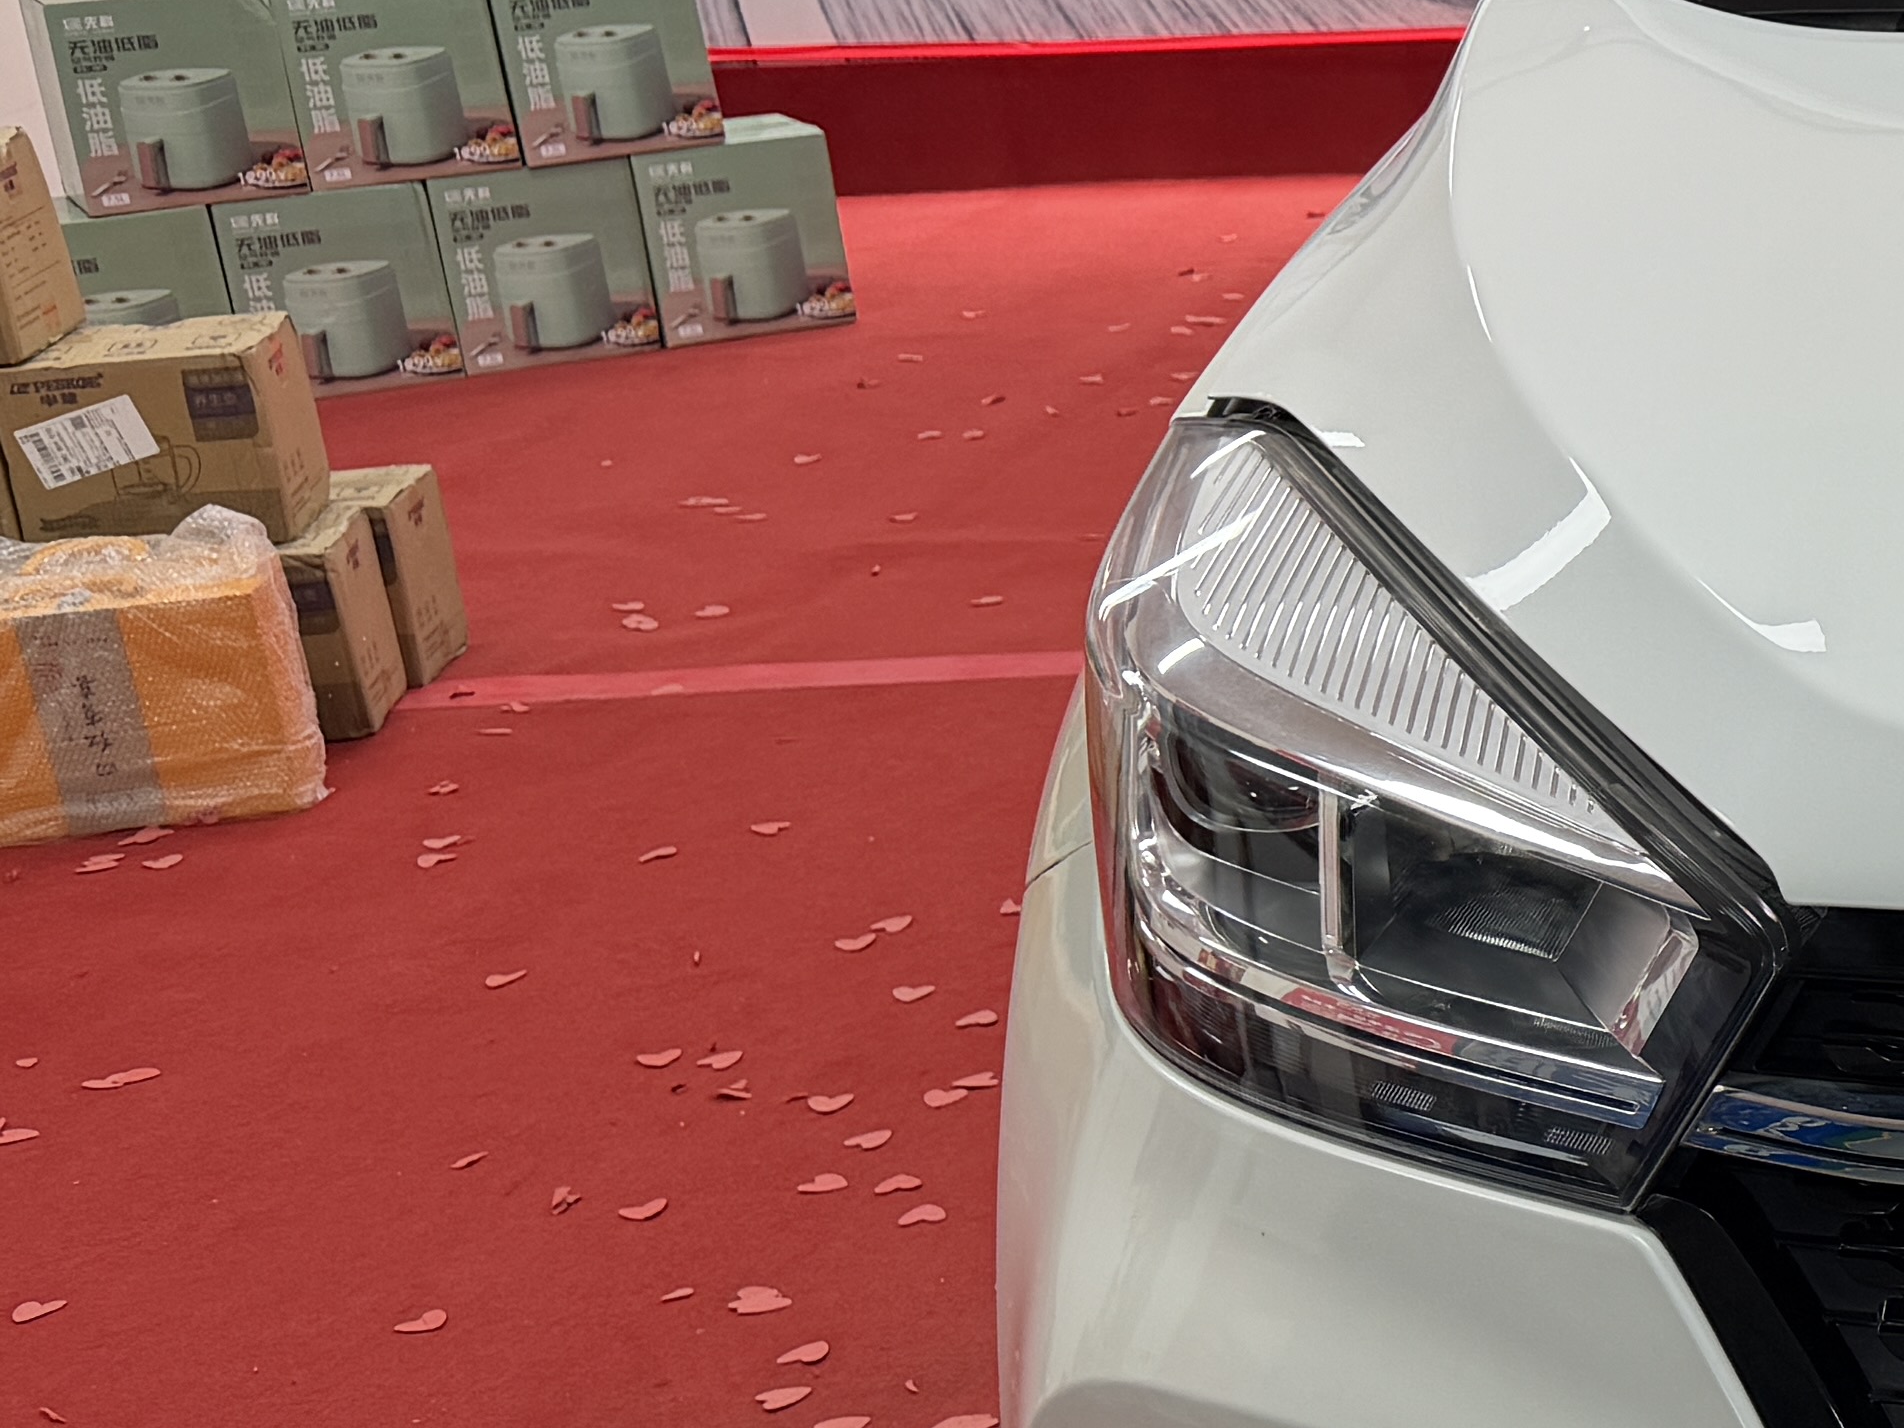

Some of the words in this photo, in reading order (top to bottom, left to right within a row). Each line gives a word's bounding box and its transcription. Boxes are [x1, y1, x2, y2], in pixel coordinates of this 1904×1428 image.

[301, 56, 341, 134] 低油脂
[517, 35, 556, 111] 低油脂
[76, 77, 120, 158] 低油脂
[456, 245, 494, 321] 低油脂
